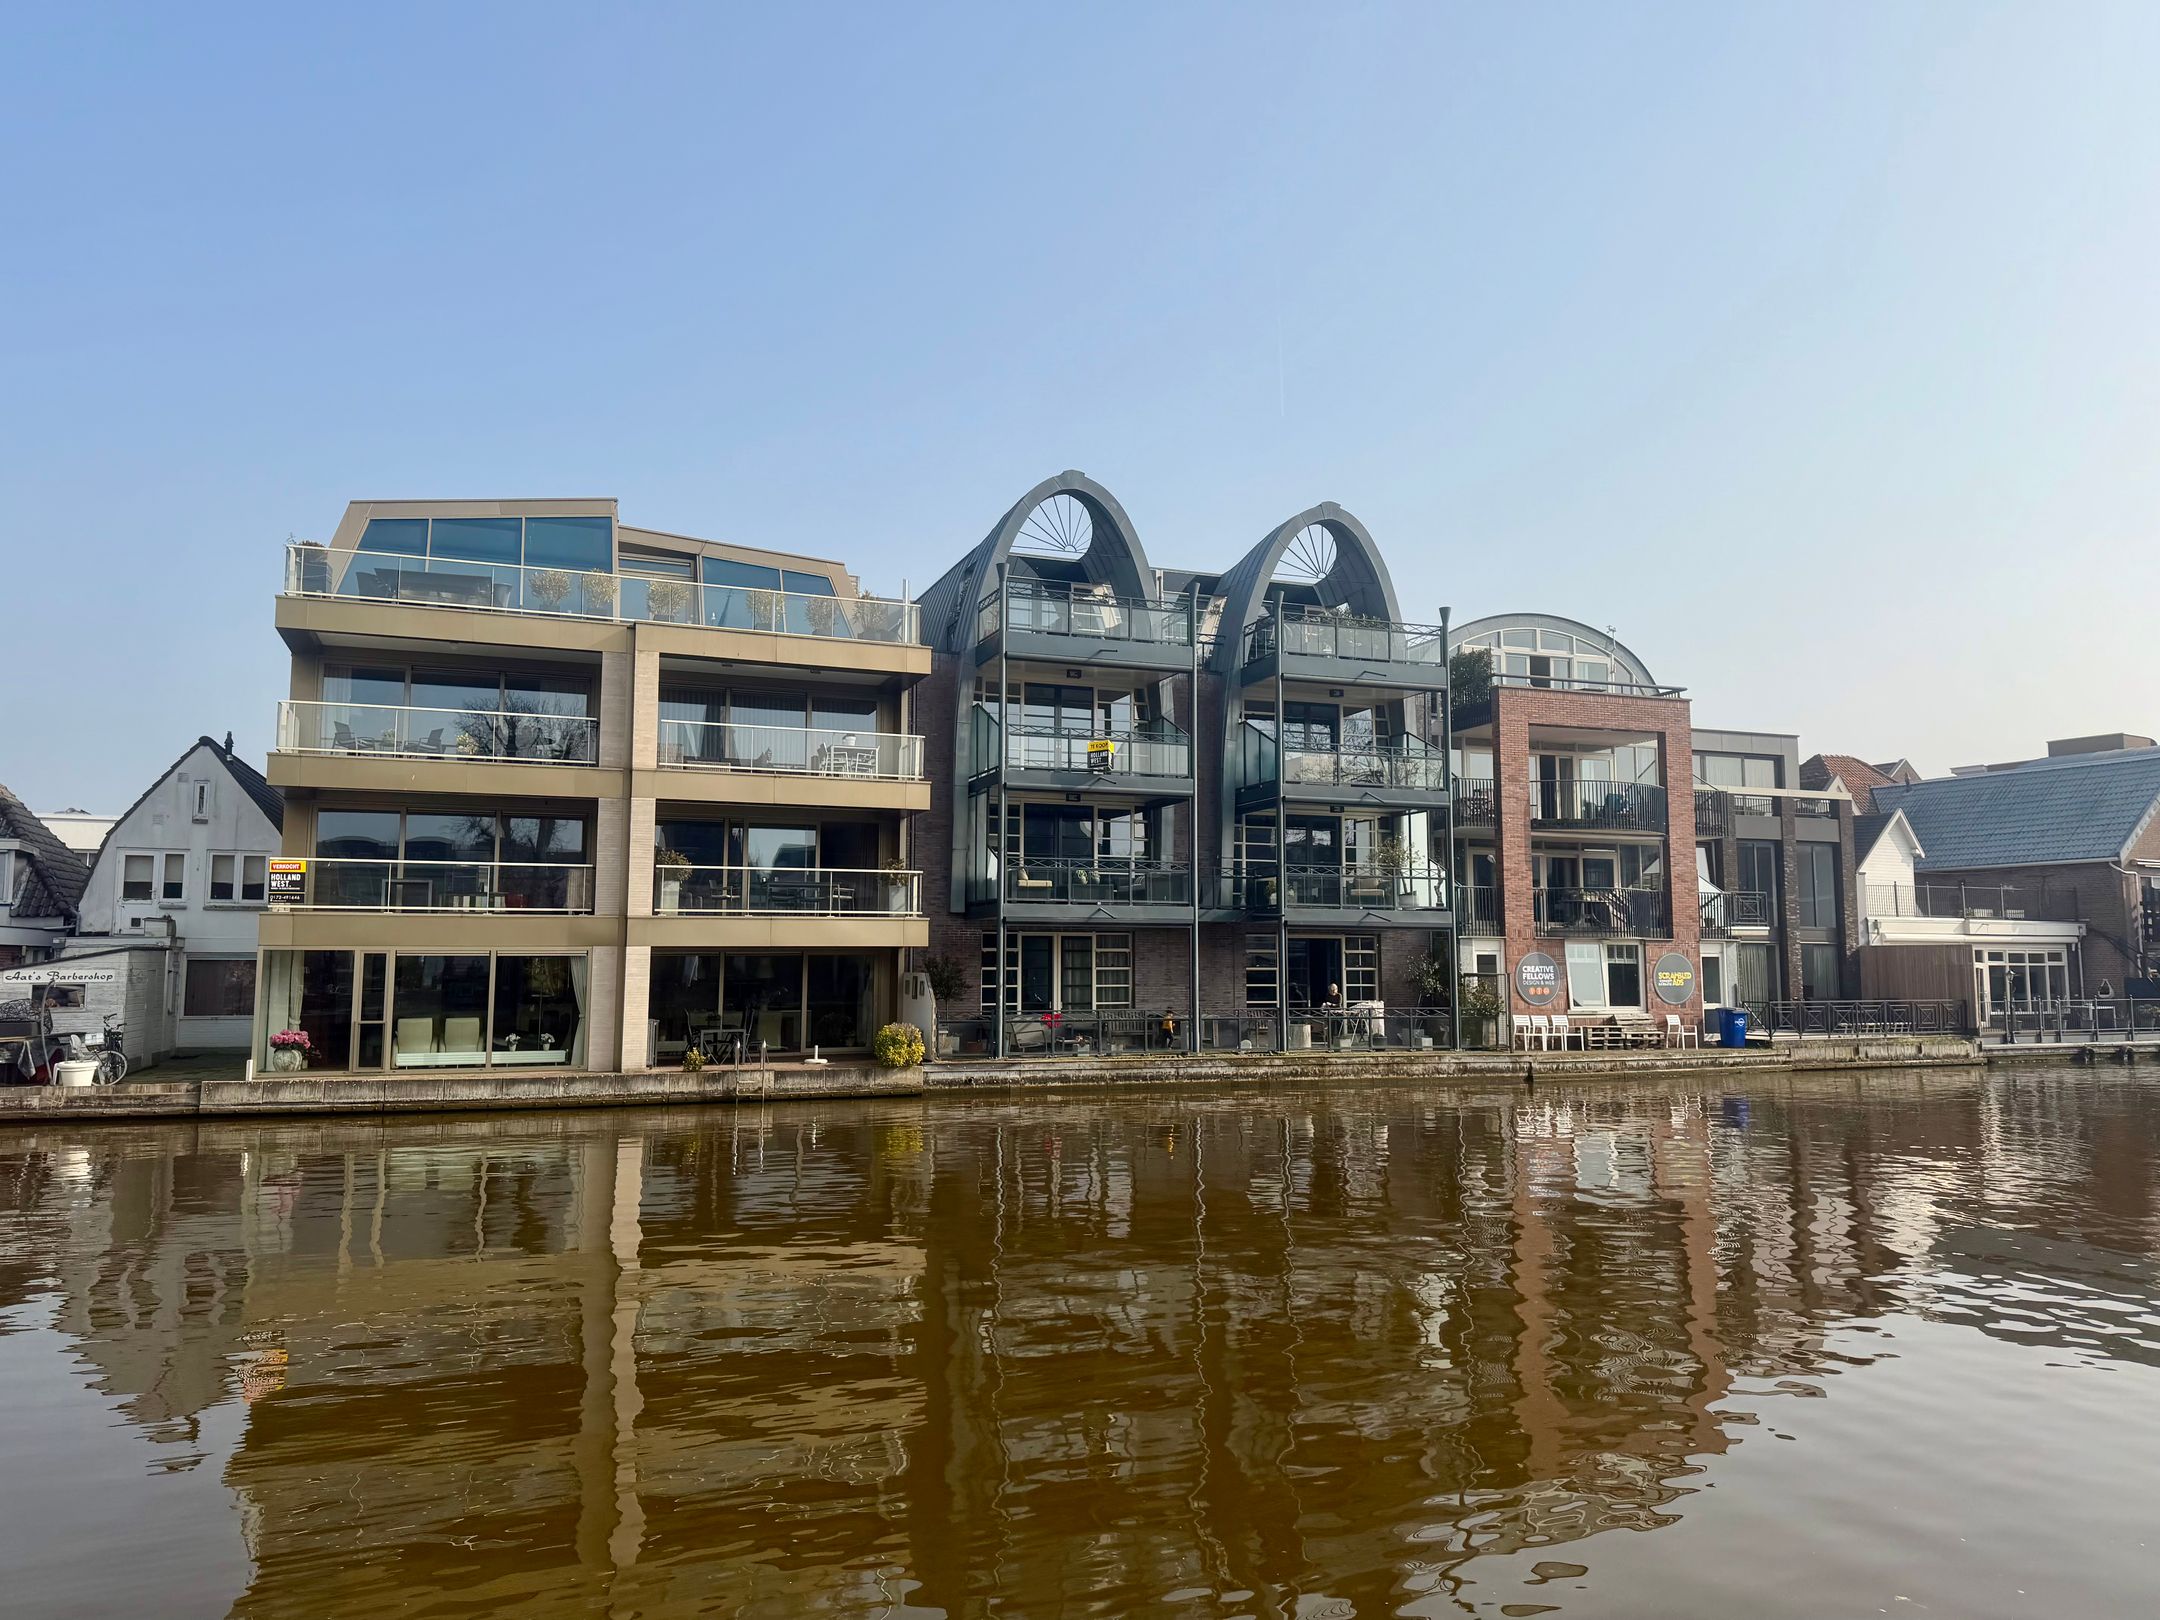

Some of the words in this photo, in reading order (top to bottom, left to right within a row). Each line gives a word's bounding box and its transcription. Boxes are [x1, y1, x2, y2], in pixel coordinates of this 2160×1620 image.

[270, 873, 301, 881] HOLLAND
[1522, 965, 1555, 973] CREATIVE
[5, 971, 41, 981] Aat's
[46, 971, 113, 981] Barbershop
